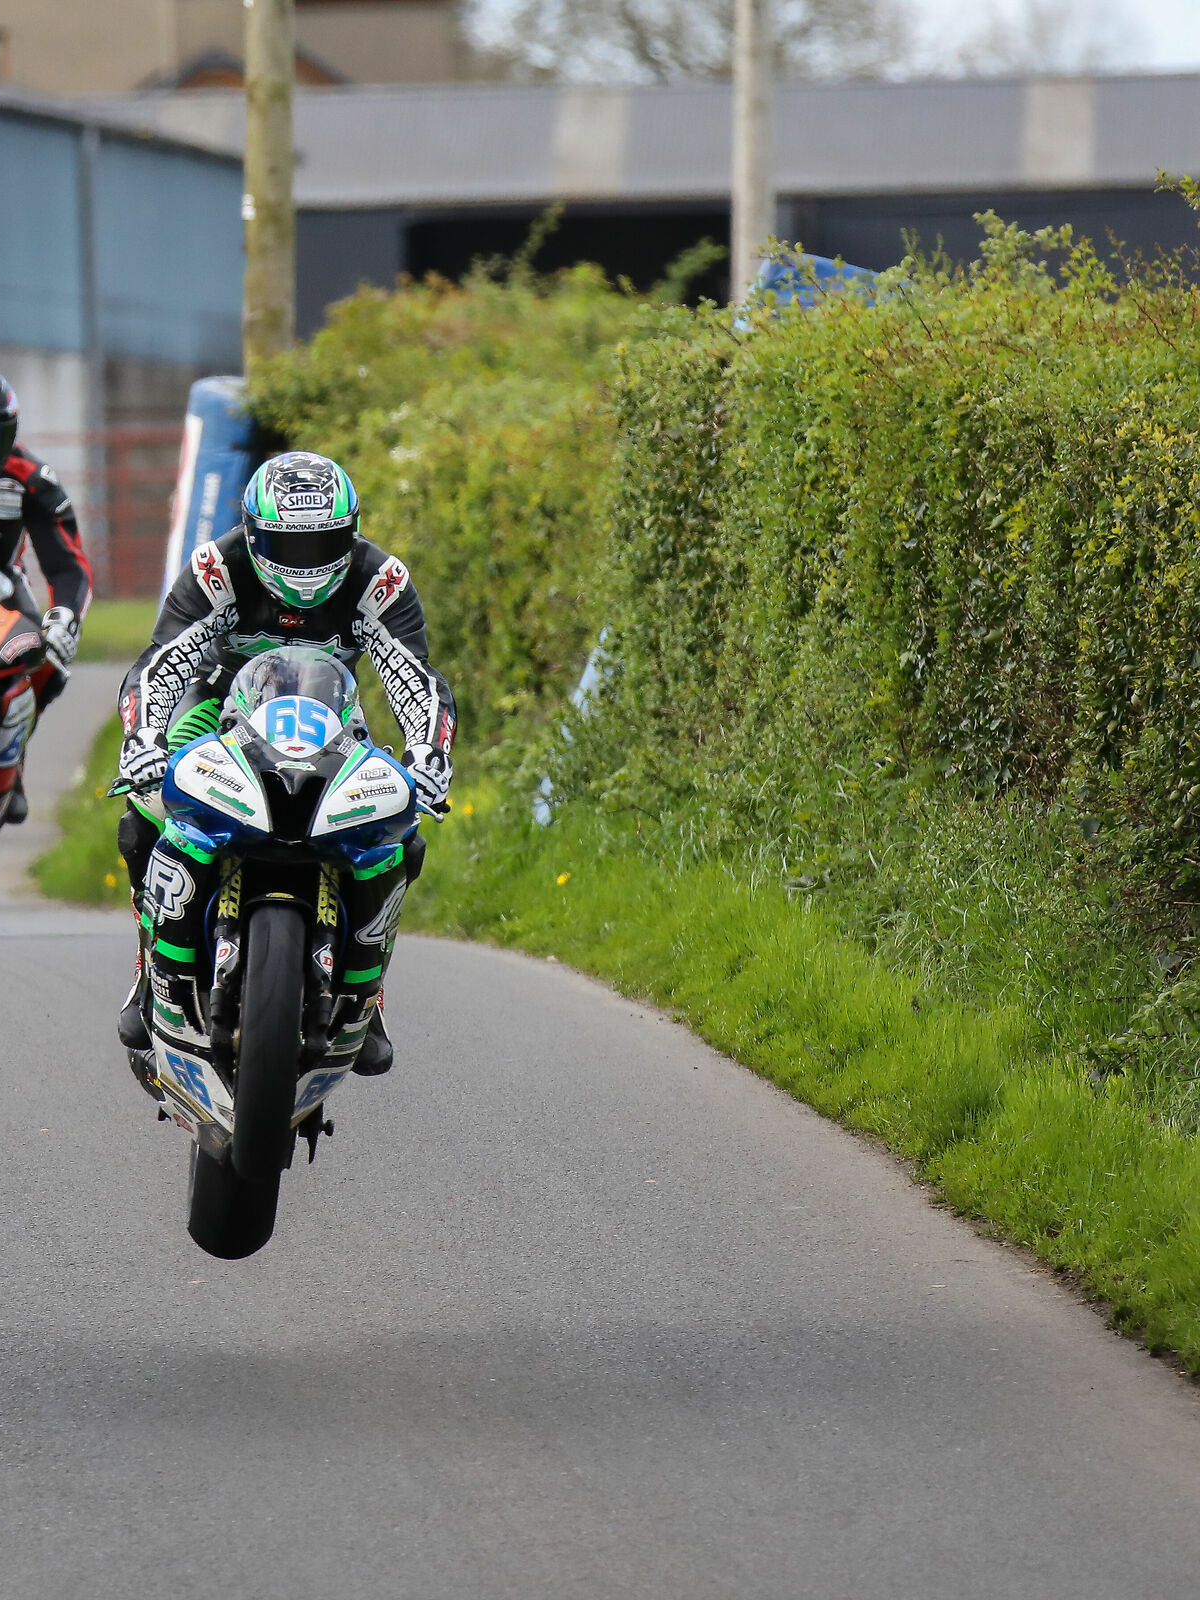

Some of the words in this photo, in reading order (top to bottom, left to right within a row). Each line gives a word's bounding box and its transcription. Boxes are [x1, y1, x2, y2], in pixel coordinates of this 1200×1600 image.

[288, 493, 323, 507] SHOEI
[264, 522, 284, 530] ROAD
[286, 523, 315, 531] RACING
[318, 519, 346, 530] IRELAND
[268, 562, 305, 576] AROUND
[307, 568, 314, 576] A
[315, 558, 345, 575] POUND
[266, 698, 329, 748] 65
[218, 948, 229, 958] D
[322, 955, 334, 967] D
